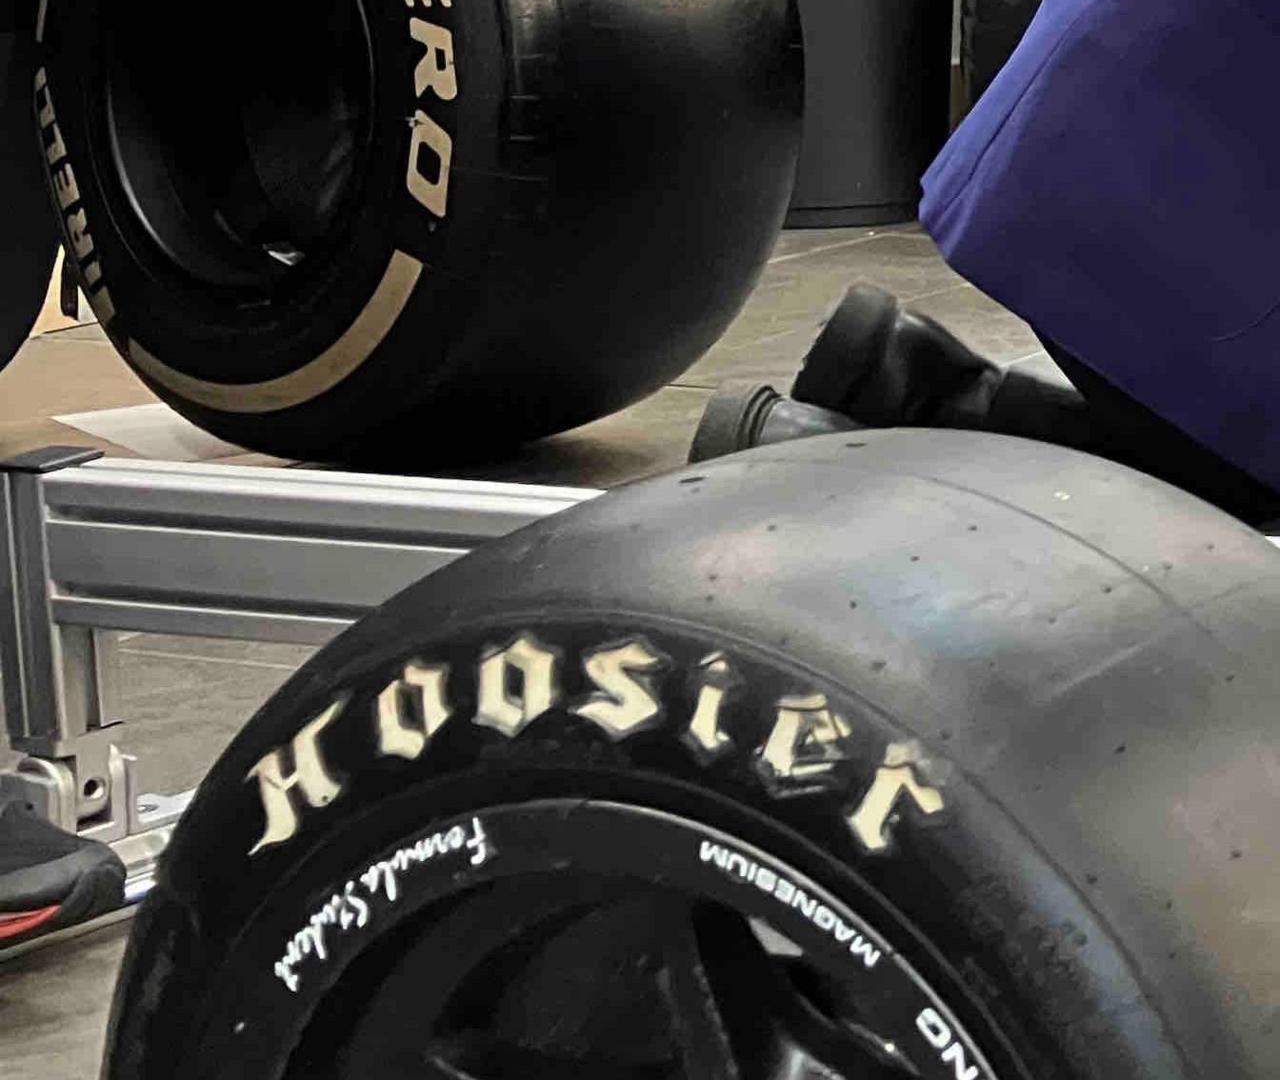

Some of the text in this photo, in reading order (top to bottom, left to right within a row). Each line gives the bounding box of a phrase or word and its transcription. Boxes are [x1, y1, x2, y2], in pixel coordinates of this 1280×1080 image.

[243, 632, 945, 856] Hoosier
[274, 817, 486, 993] Formula Student
[700, 840, 882, 968] MAGNESIUM
